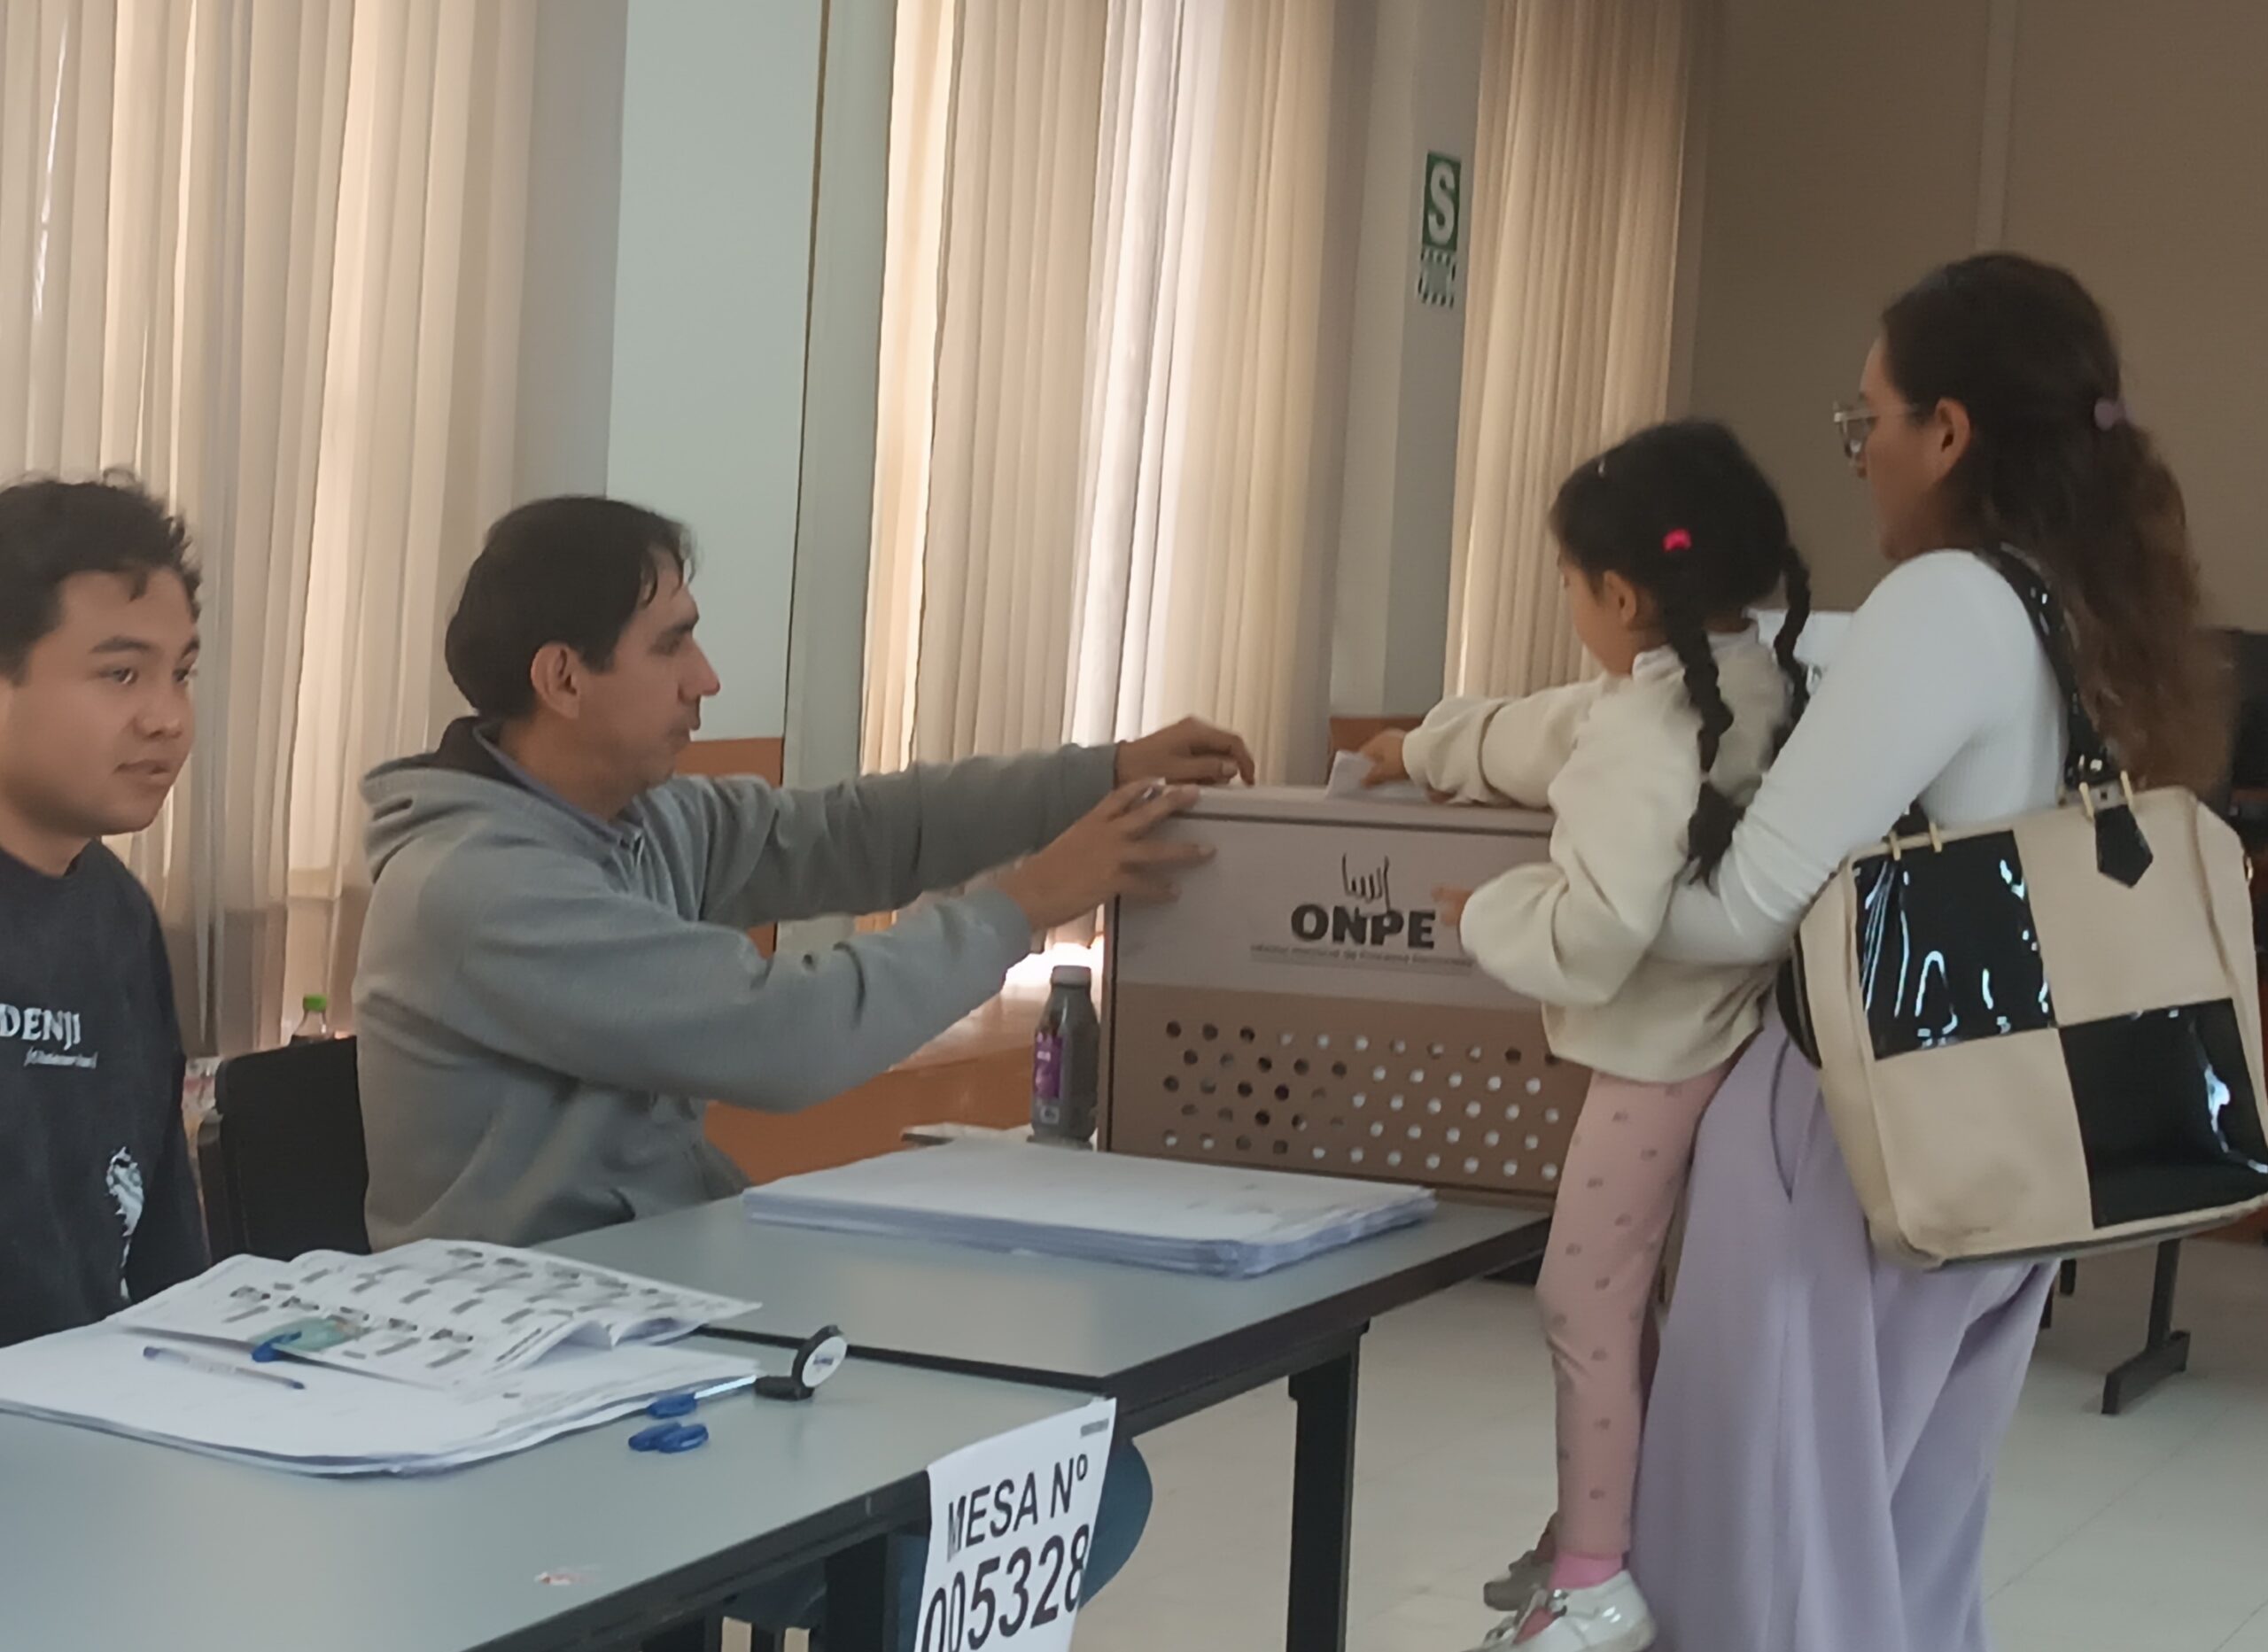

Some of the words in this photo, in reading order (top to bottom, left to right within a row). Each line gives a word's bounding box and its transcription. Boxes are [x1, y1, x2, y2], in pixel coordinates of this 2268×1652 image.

[1428, 161, 1456, 245] S
[1291, 904, 1436, 950] ONPE
[0, 1003, 81, 1051] DENJI
[947, 1471, 1037, 1562] MESA
[921, 1524, 1090, 1652] 005328
